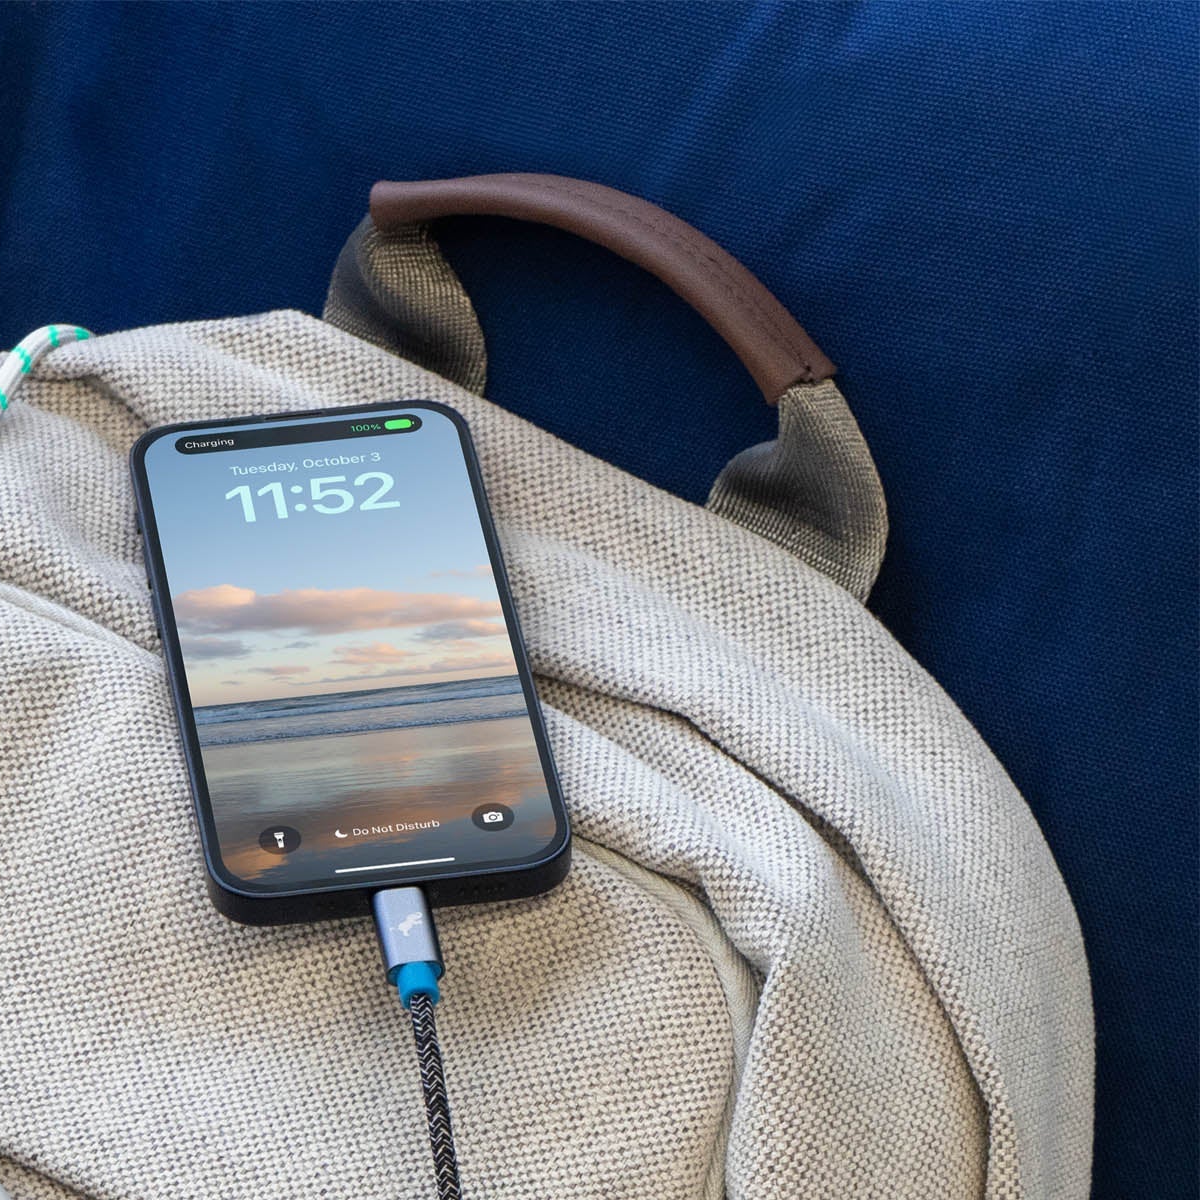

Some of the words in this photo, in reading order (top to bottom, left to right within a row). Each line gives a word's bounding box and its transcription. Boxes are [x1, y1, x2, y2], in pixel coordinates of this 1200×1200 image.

[184, 437, 235, 450] Charging
[350, 423, 382, 433] 100%
[229, 462, 299, 477] Tuesday,
[303, 453, 366, 470] October
[370, 452, 381, 463] 3
[224, 471, 401, 523] 11:52
[352, 827, 369, 837] Do
[372, 823, 394, 835] Not
[396, 819, 440, 832] Disturb
